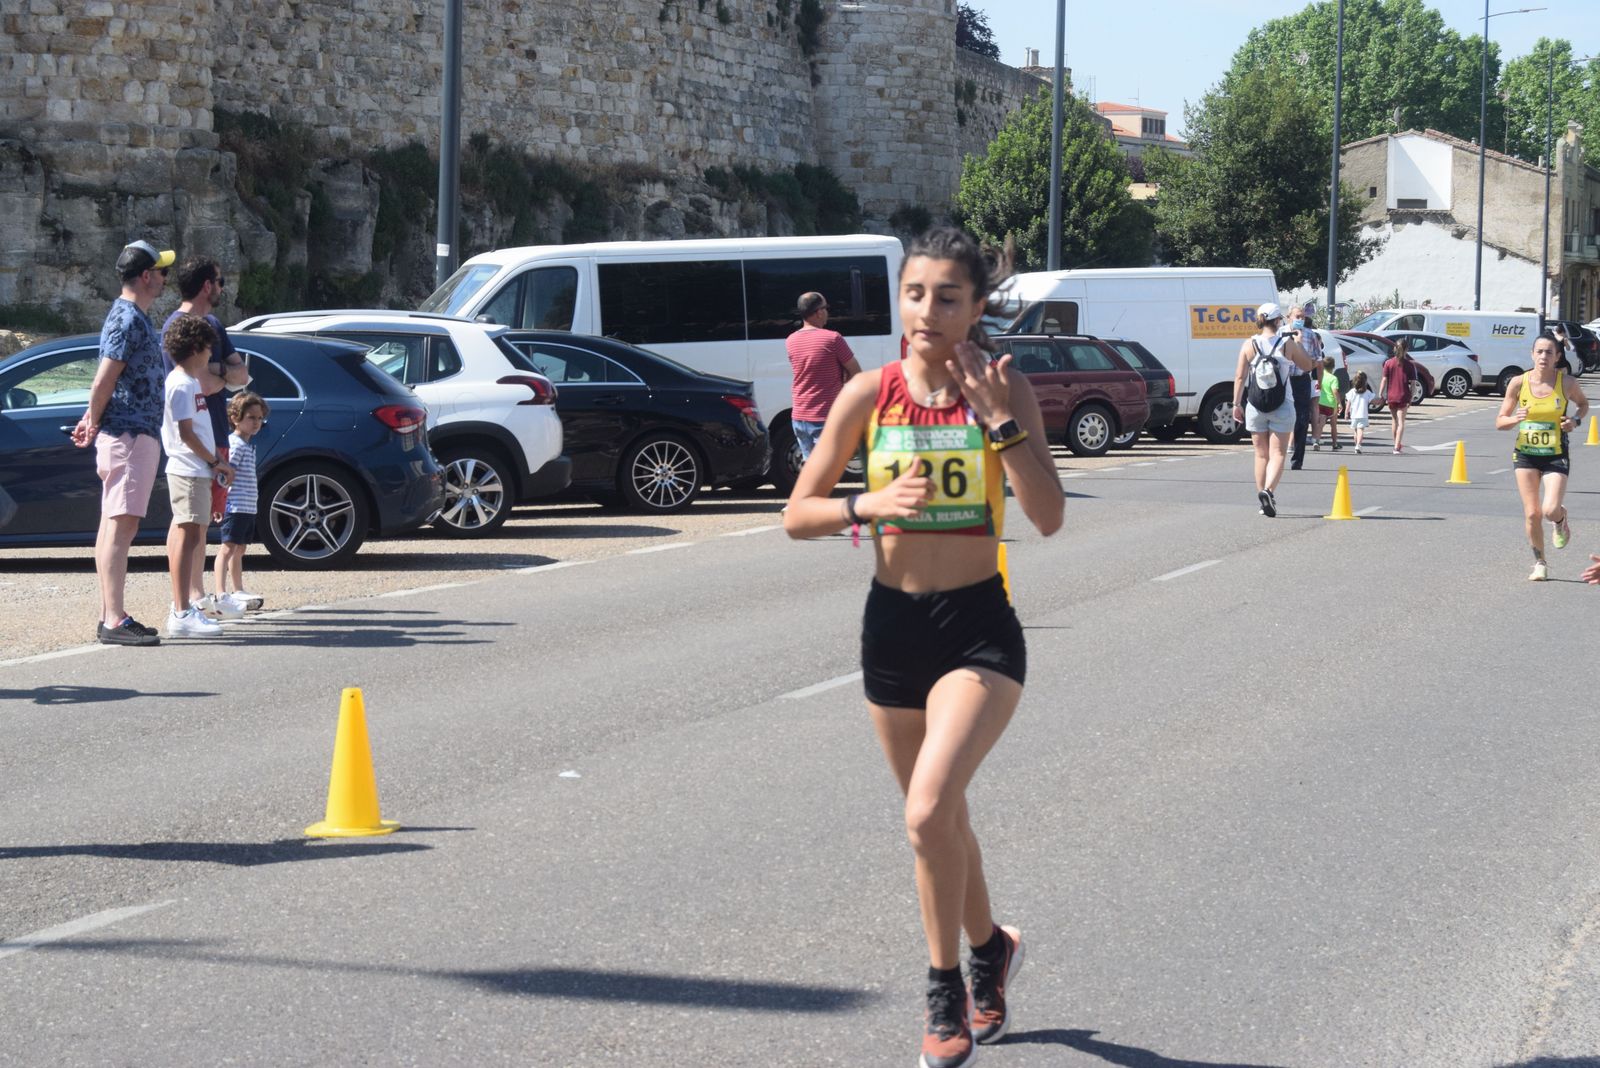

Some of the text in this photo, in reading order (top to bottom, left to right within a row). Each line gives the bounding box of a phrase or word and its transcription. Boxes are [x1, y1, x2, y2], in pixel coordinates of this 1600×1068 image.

[1492, 323, 1526, 336] Hertz
[931, 439, 968, 449] RURAL
[1524, 431, 1550, 445] 160
[936, 509, 979, 522] RURAL
